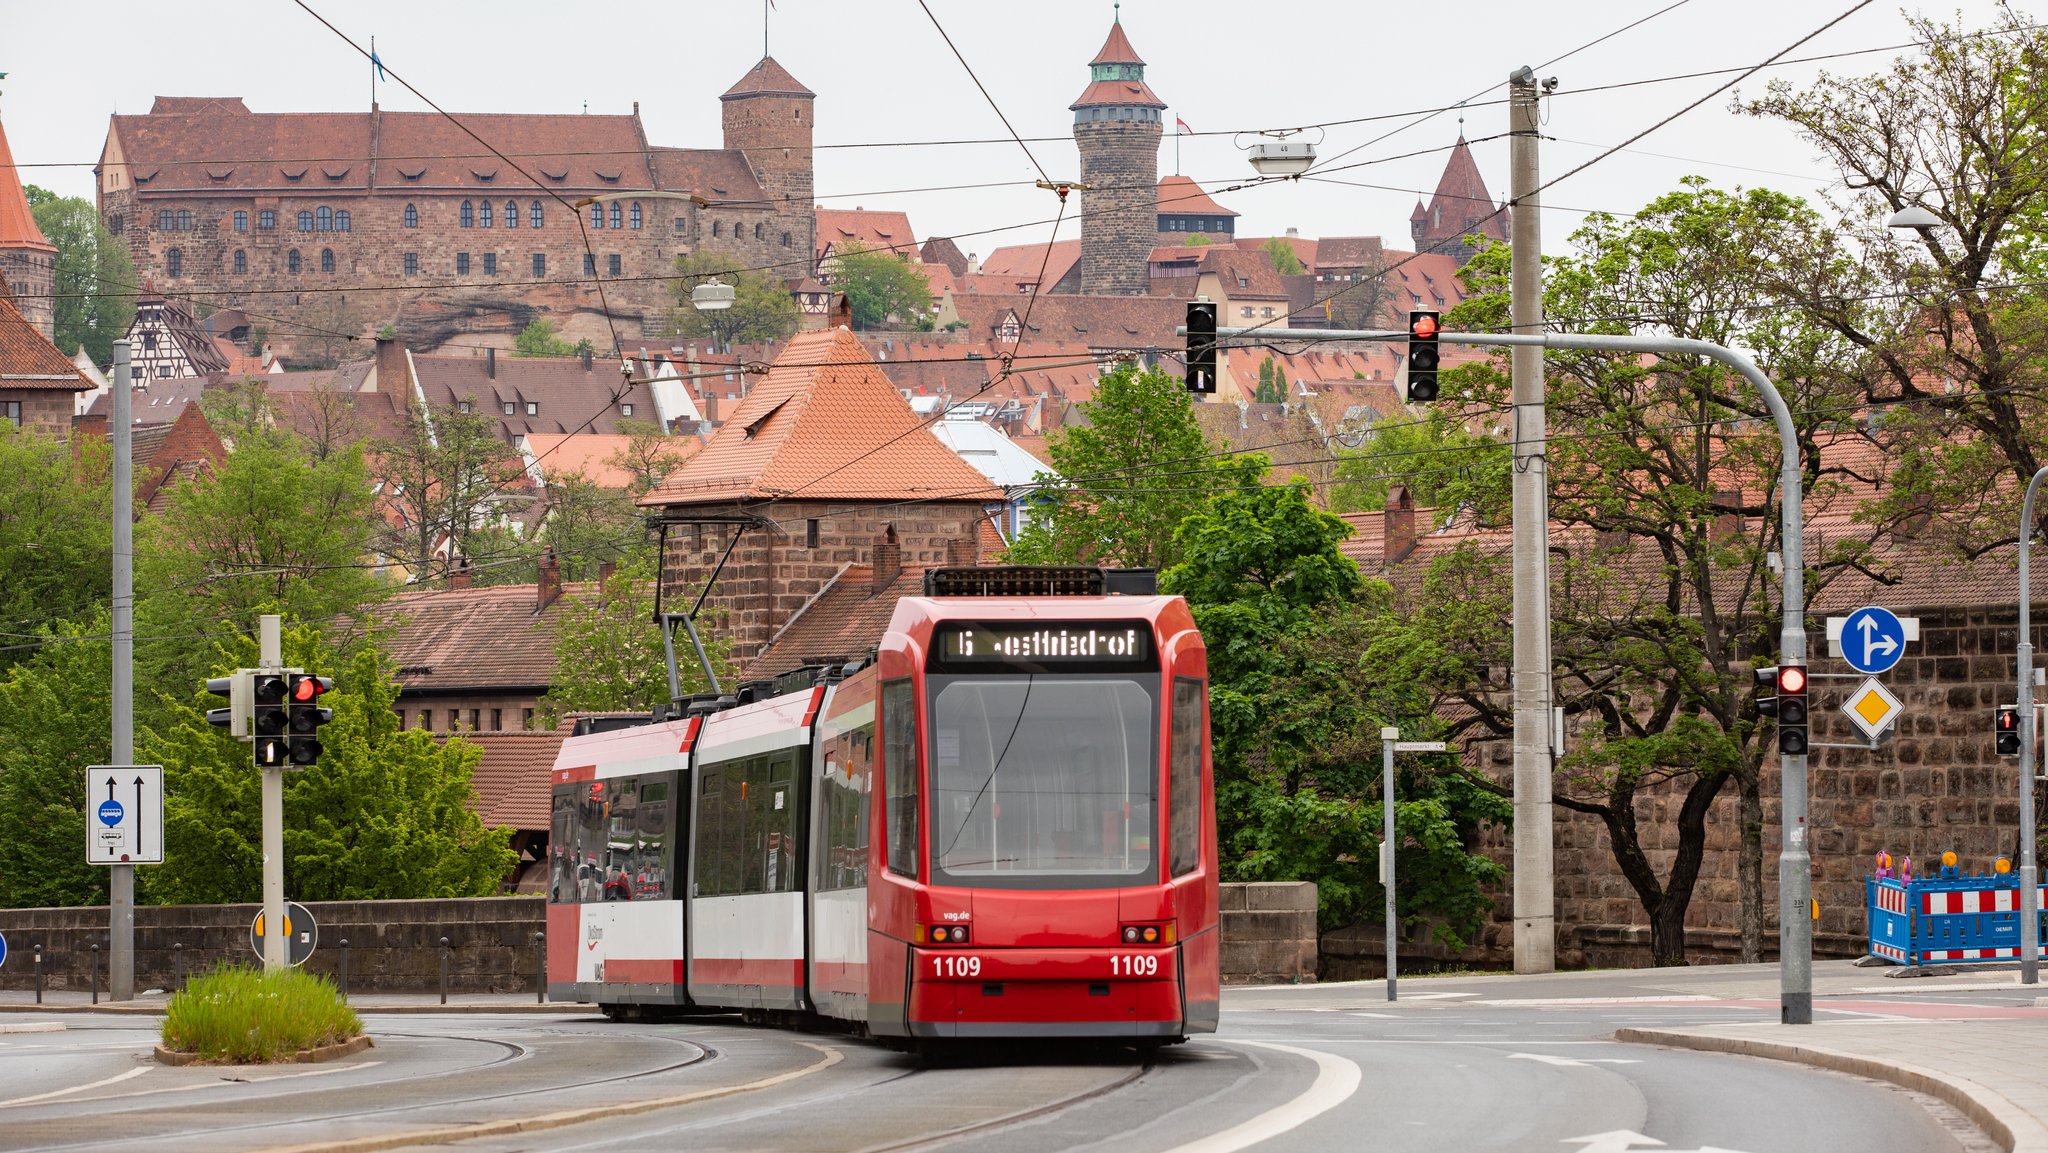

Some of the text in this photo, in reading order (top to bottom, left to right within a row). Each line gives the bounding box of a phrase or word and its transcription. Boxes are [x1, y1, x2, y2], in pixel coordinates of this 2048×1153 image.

[943, 911, 970, 922] vag.de
[932, 955, 981, 977] 1109
[1109, 954, 1158, 976] 1109
